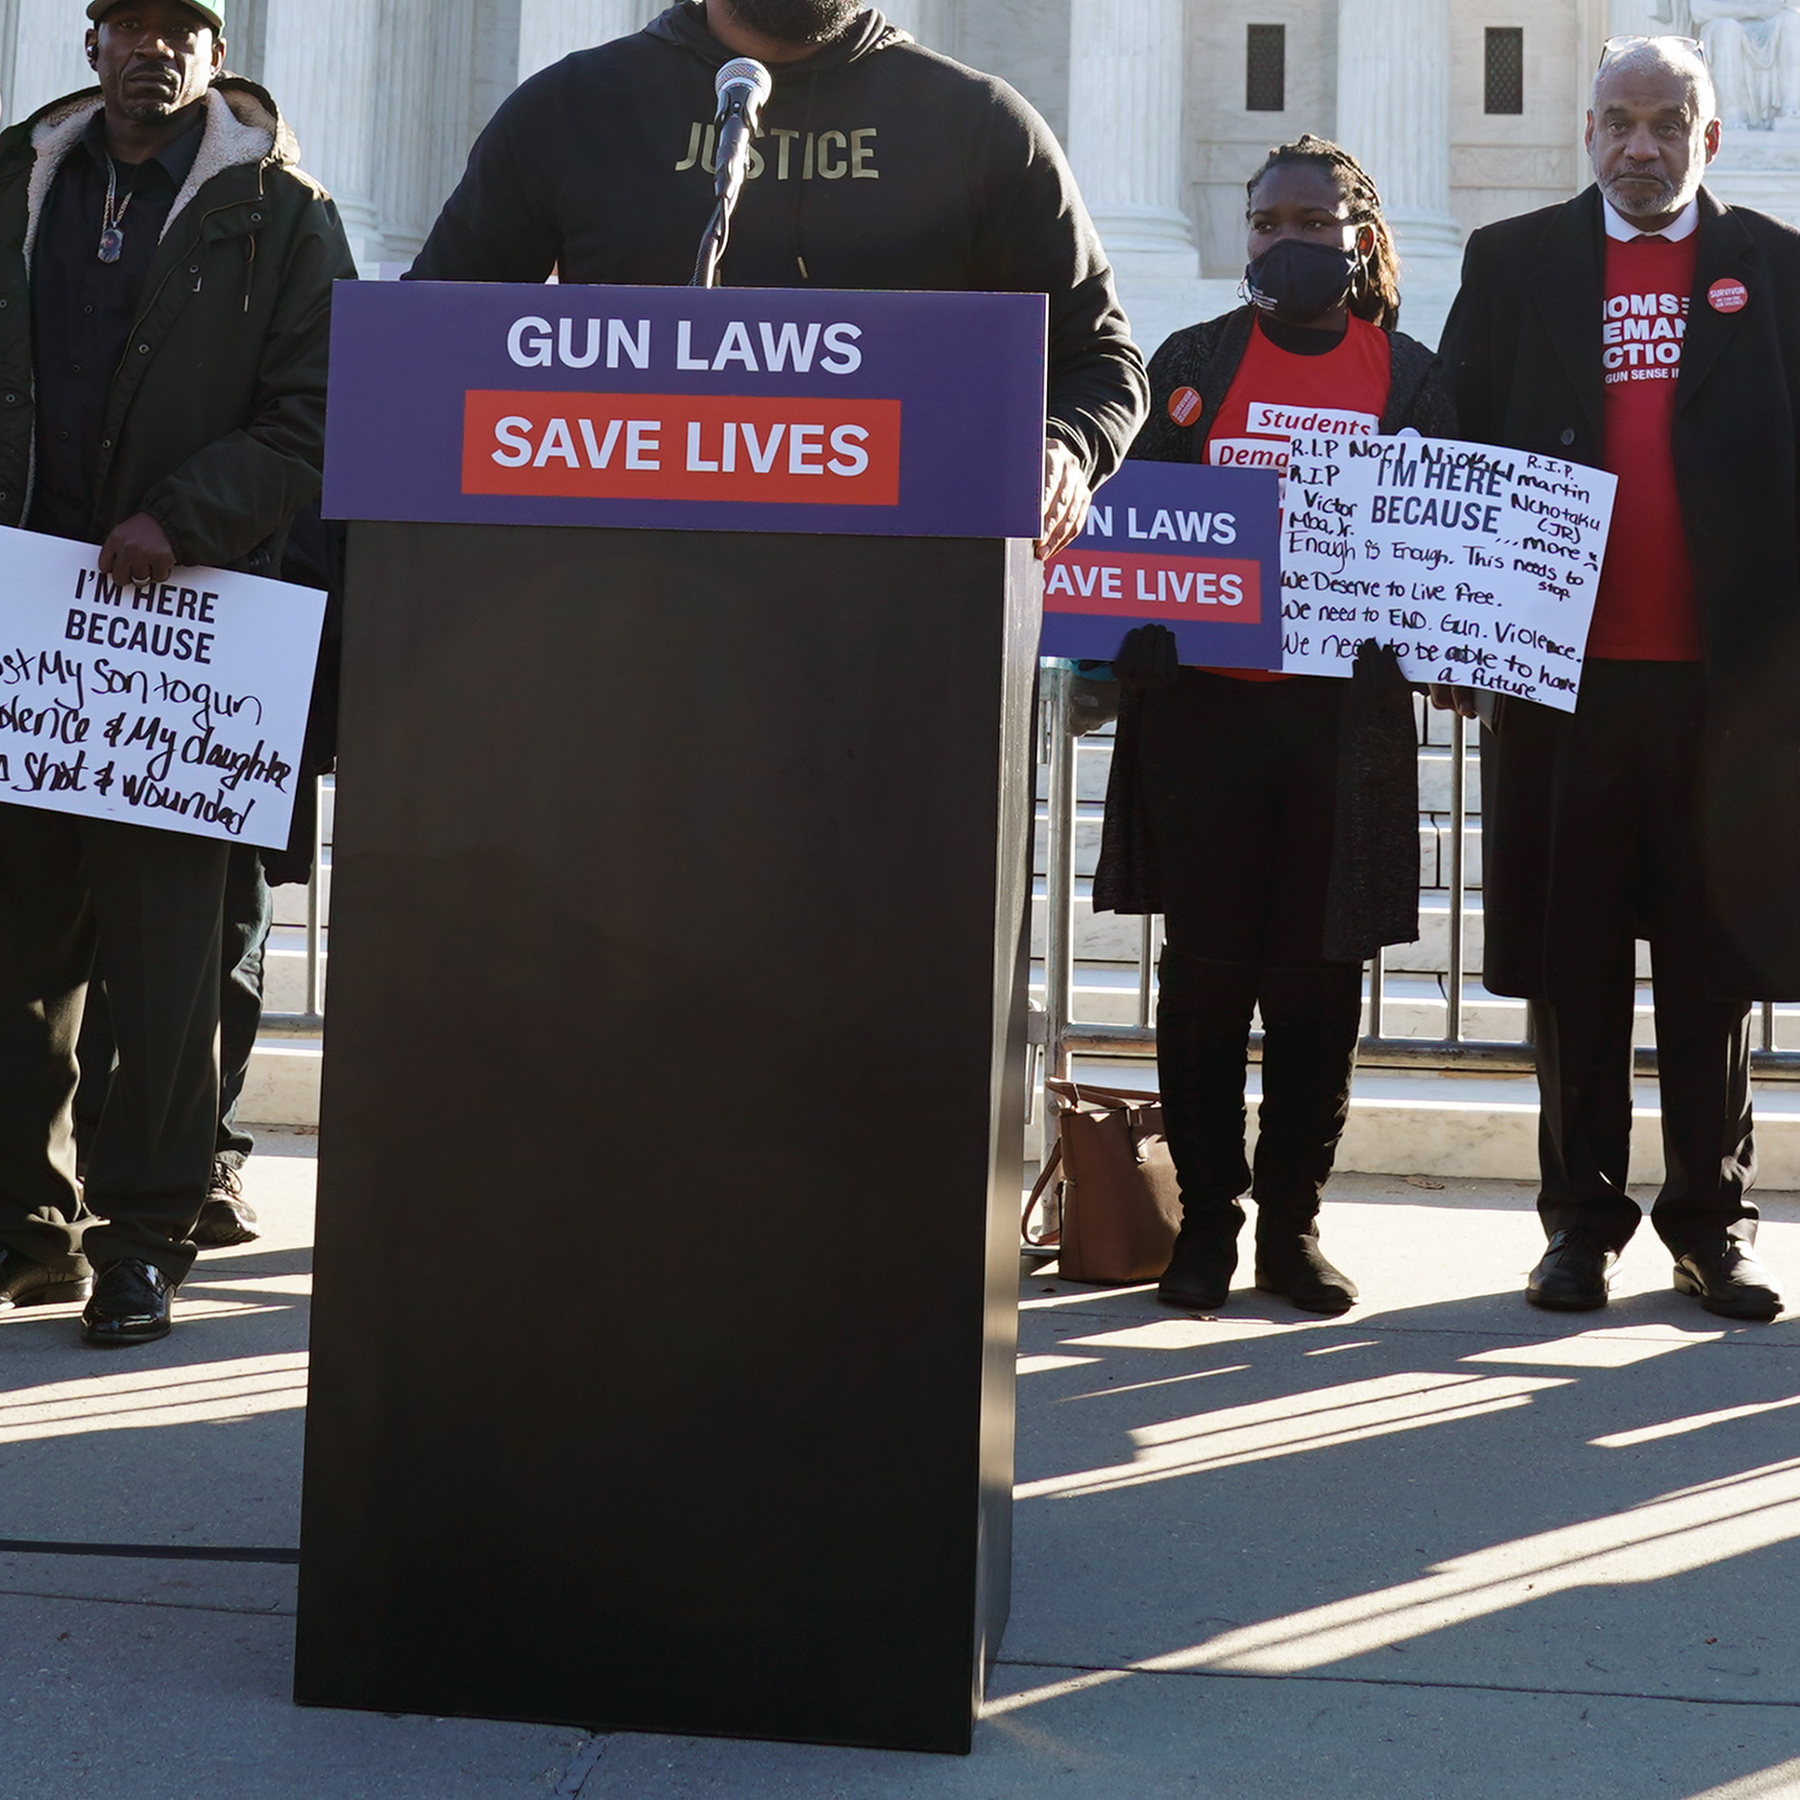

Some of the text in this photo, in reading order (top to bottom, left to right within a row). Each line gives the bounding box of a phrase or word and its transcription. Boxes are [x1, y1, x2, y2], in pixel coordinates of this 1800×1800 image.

[1603, 293, 1680, 321] OMS
[506, 315, 864, 375] GUN LAWS
[1603, 317, 1687, 345] EMAN
[1602, 342, 1682, 369] CTIO
[1605, 370, 1628, 384] GUN
[1631, 368, 1669, 381] SENSE
[1257, 408, 1372, 436] Students
[491, 415, 871, 477] SAVE LIVES
[1218, 445, 1290, 468] Dema
[1424, 458, 1502, 498] HERE
[1128, 506, 1237, 545] LAWS
[1371, 495, 1503, 535] BECAUSE
[1462, 545, 1505, 569] This
[75, 568, 219, 624] I'M HERE
[1044, 563, 1243, 606] AVE LIVES
[1386, 581, 1406, 598] to
[1319, 606, 1357, 622] need
[1362, 606, 1380, 623] to
[65, 608, 215, 665] BECAUSE
[1322, 634, 1372, 658] nee
[1504, 655, 1532, 678] to
